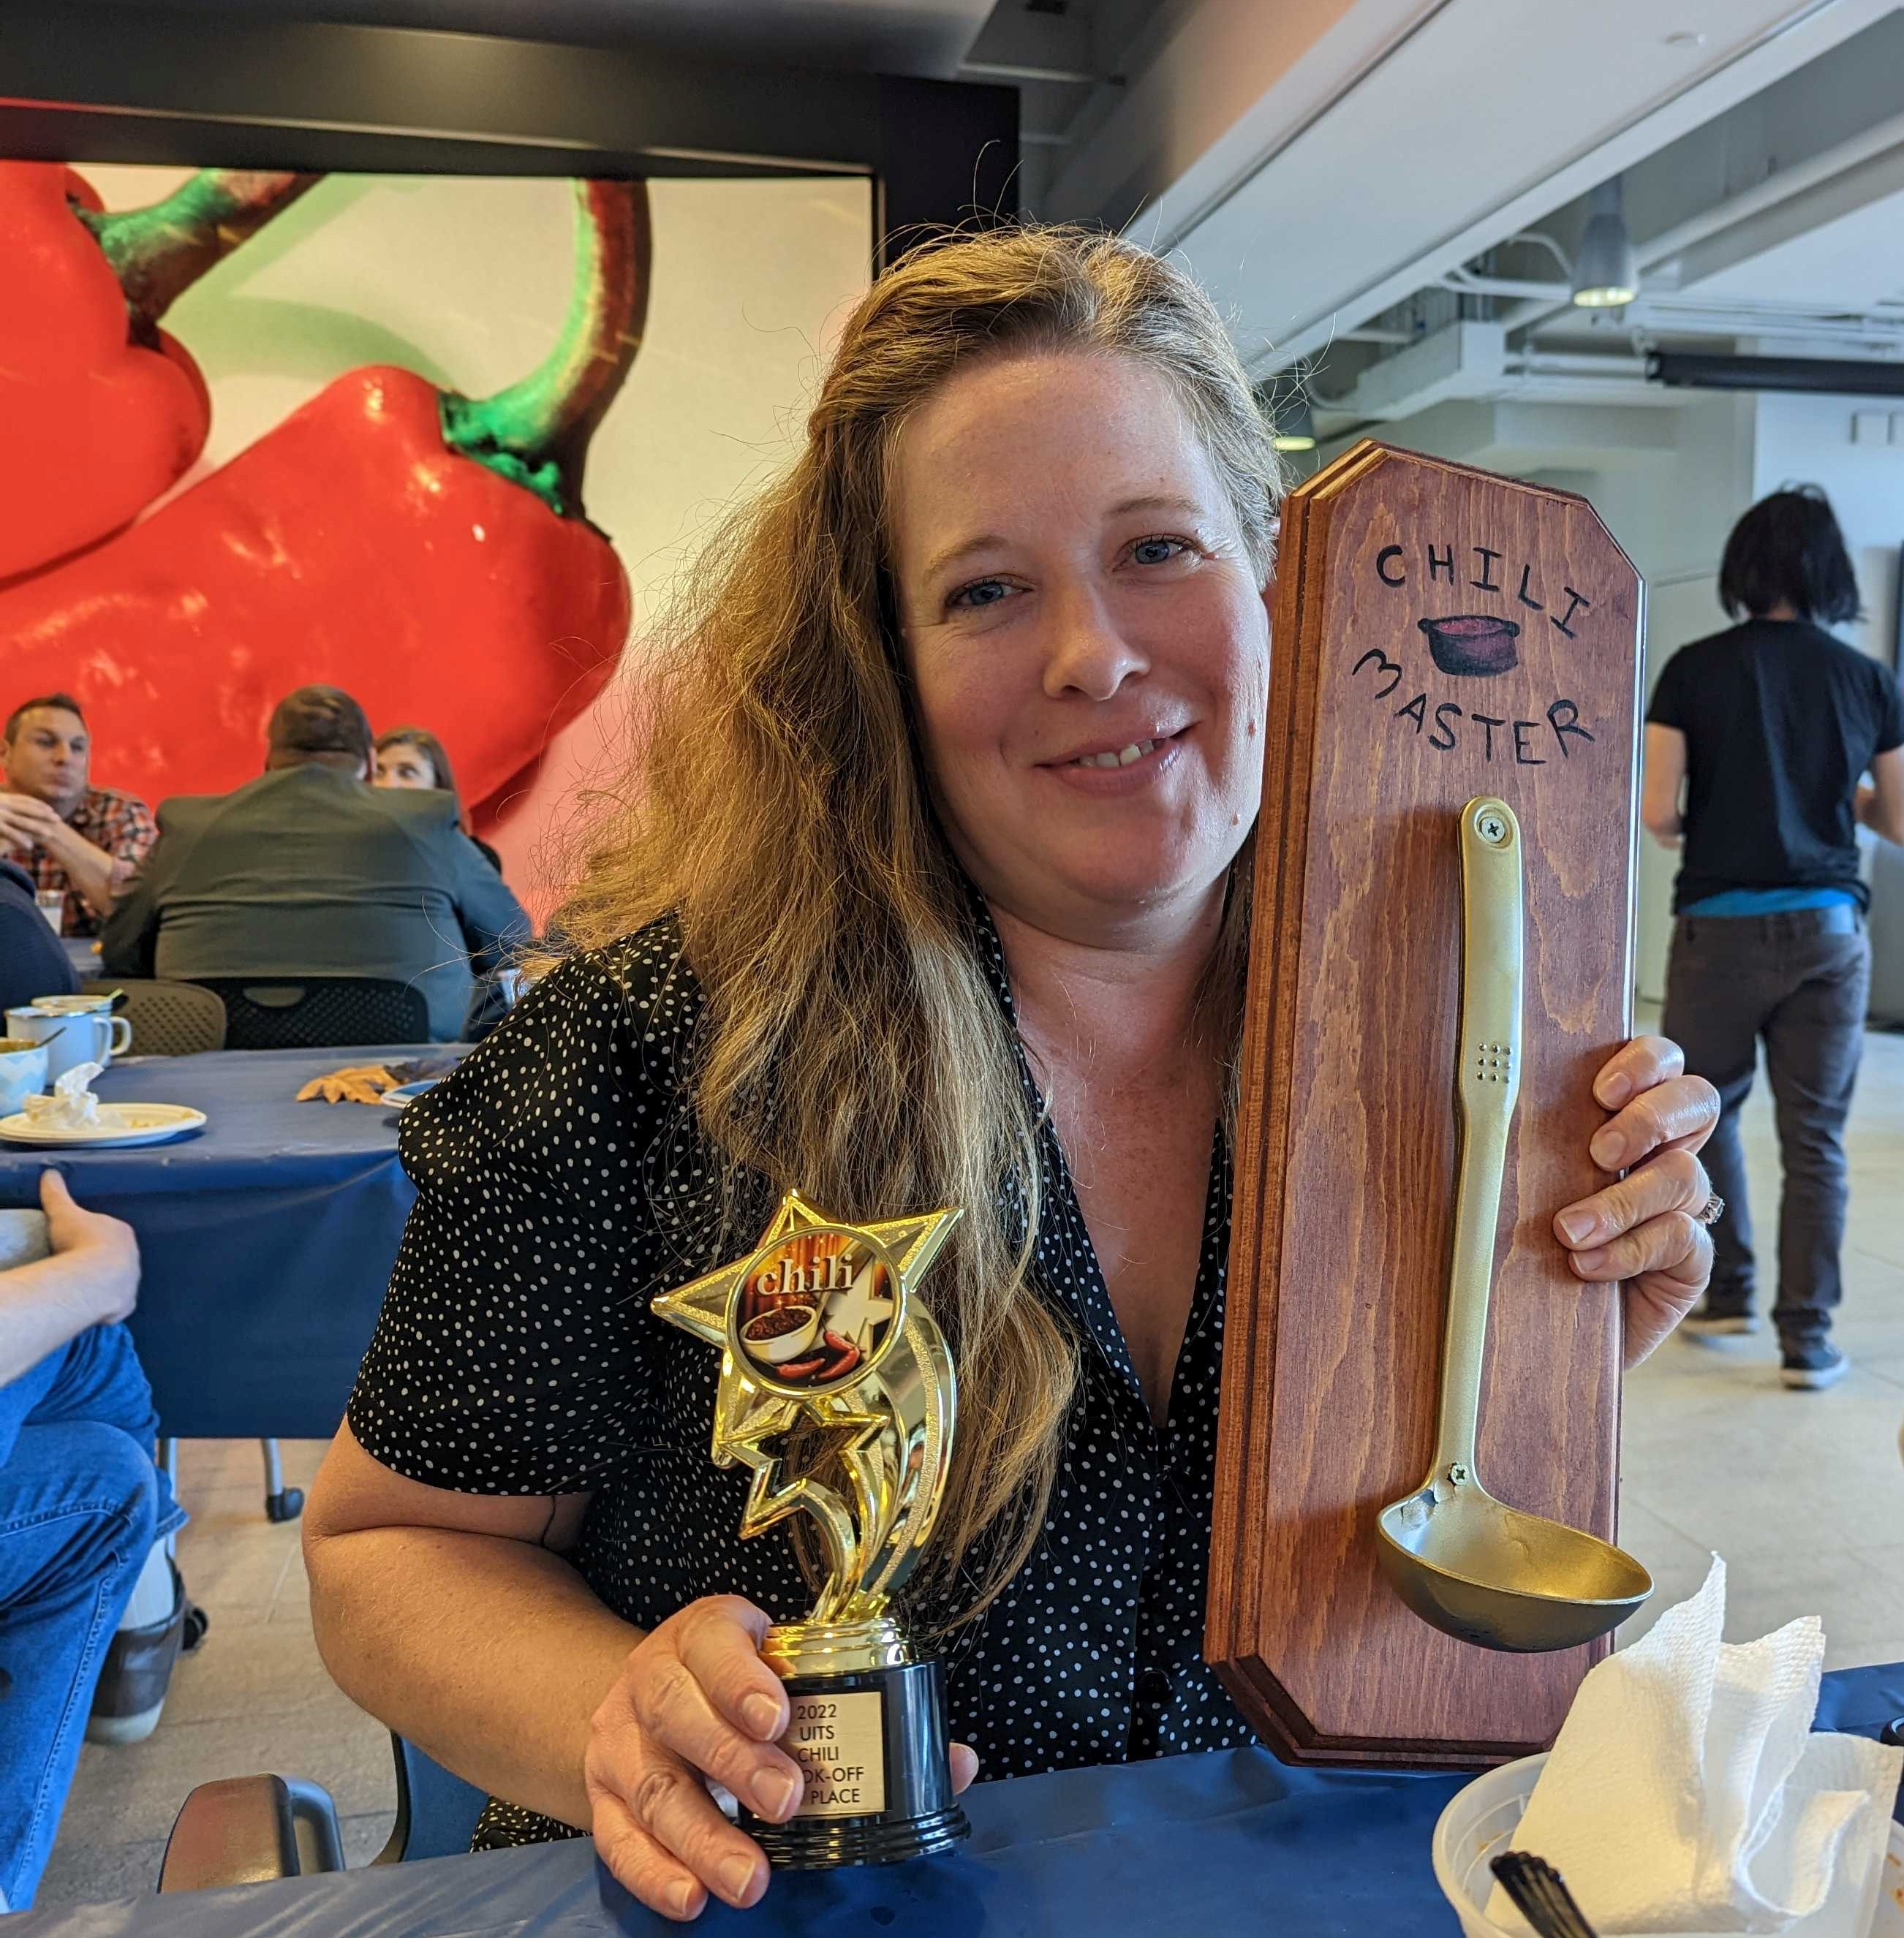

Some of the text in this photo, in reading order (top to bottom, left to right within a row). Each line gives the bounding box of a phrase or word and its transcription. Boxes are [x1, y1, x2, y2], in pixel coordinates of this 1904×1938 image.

[1376, 544, 1590, 640] CHILI
[1352, 648, 1595, 765] MASTER
[756, 1253, 853, 1296] chili
[797, 1704, 837, 1719] 2022
[800, 1725, 835, 1741] UITS
[798, 1746, 839, 1763] CHILI
[804, 1766, 864, 1784] OK-OFF
[811, 1788, 861, 1804] PLACE
